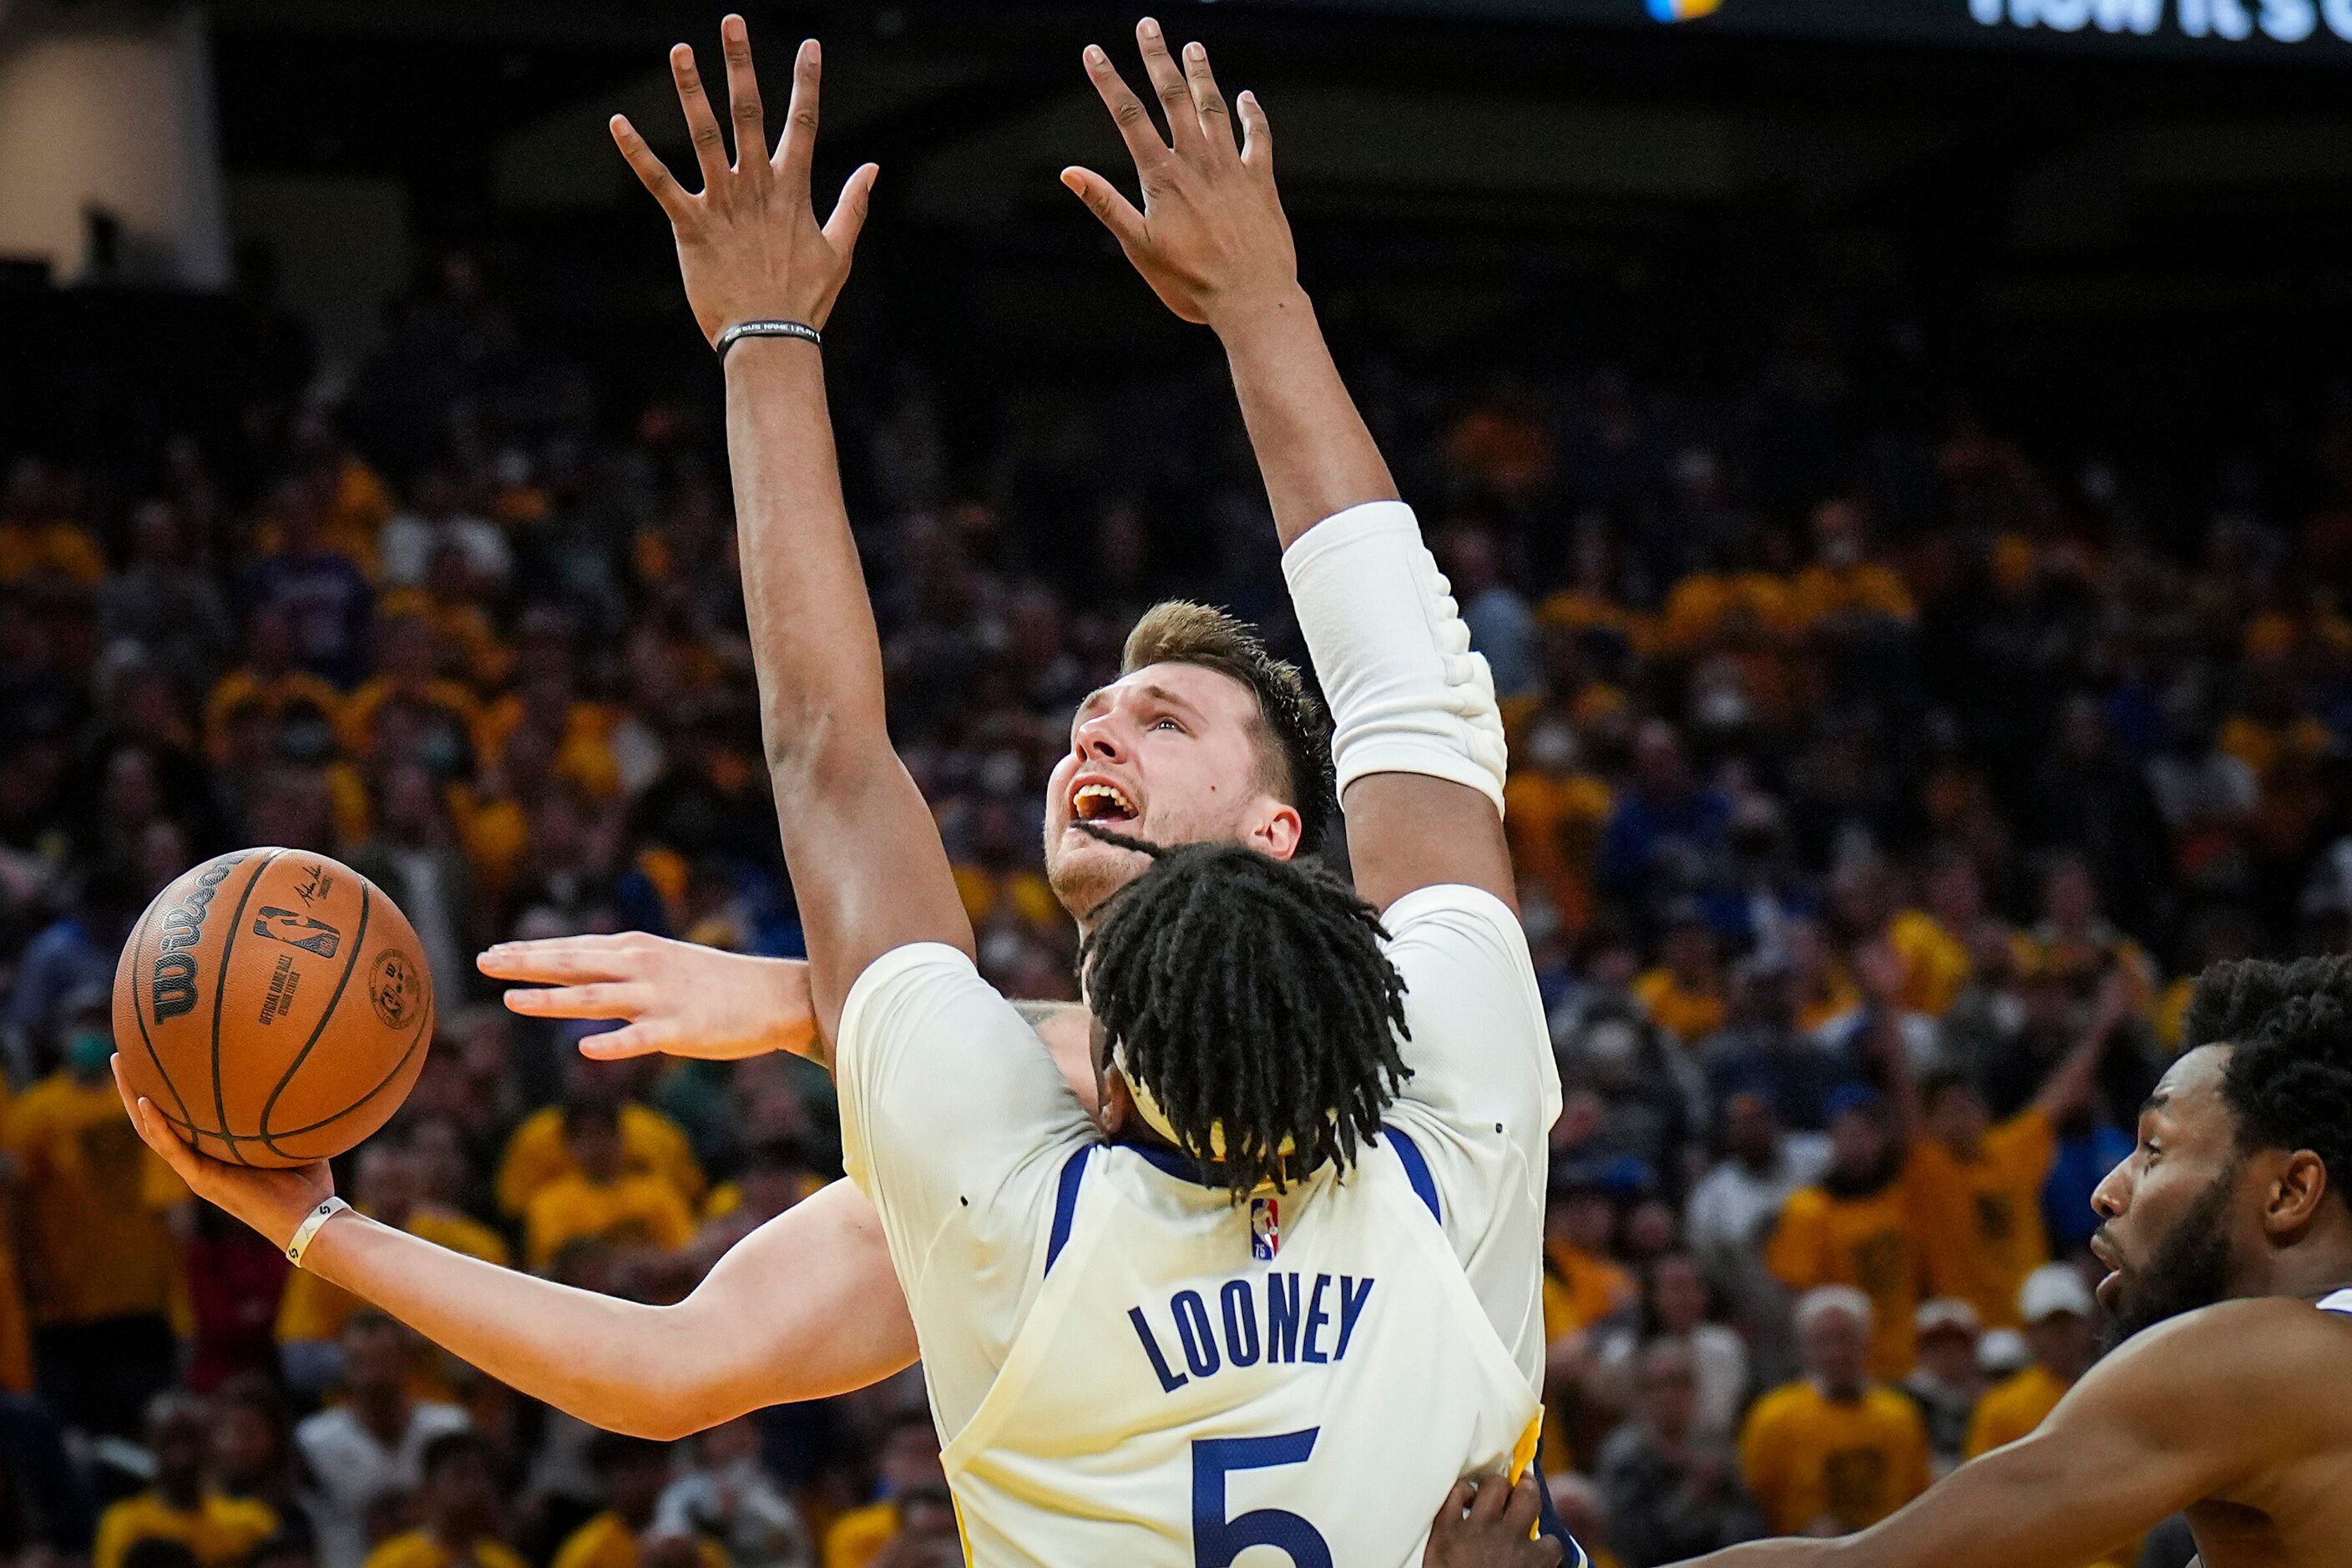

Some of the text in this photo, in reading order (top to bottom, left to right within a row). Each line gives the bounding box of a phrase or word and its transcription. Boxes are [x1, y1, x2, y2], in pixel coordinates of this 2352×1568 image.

[763, 322, 789, 331] NAME
[258, 953, 293, 1025] OFFICIAL GAME BALL
[1127, 1272, 1375, 1393] LOONEY
[1191, 1426, 1333, 1568] 5
